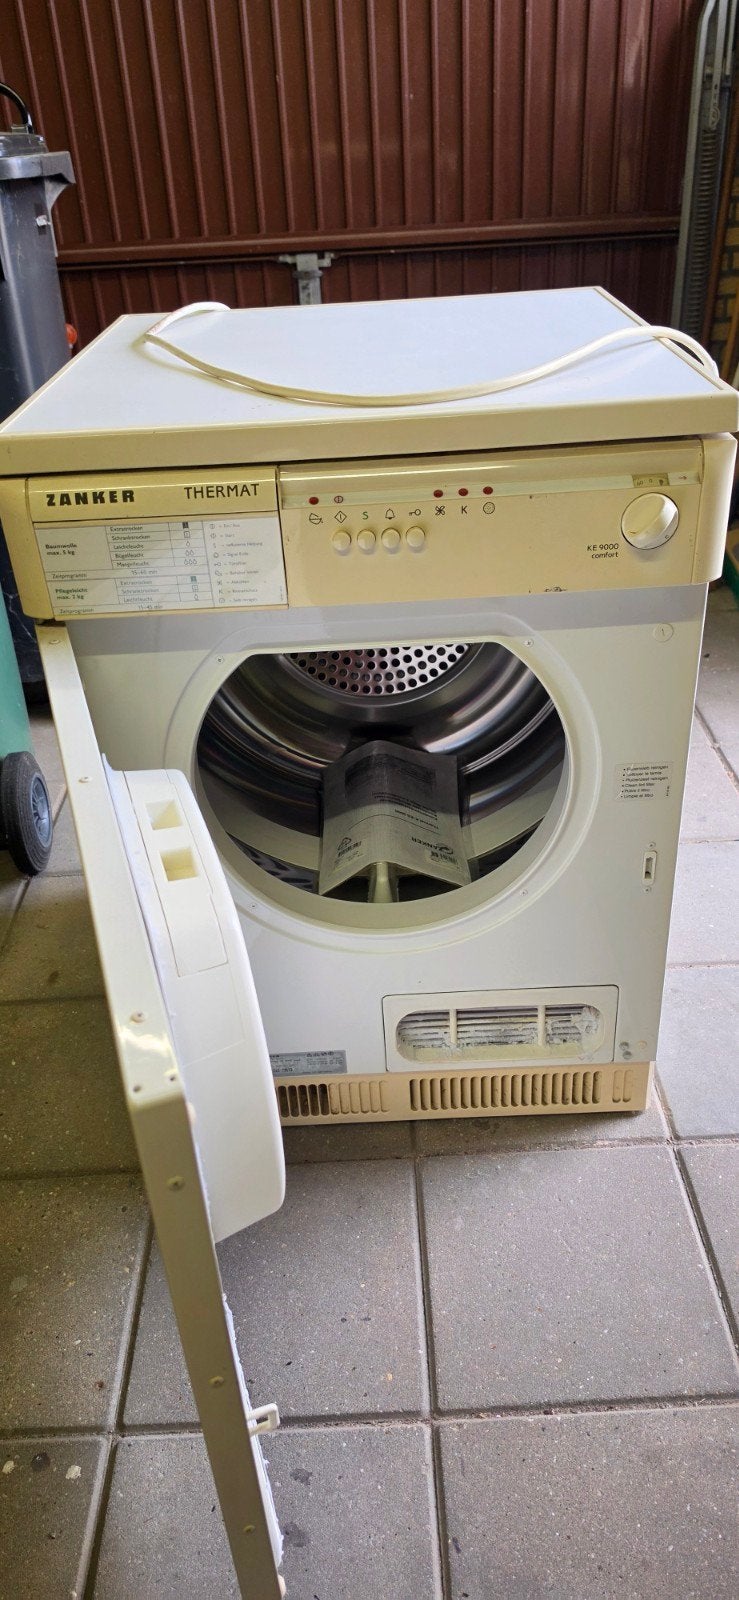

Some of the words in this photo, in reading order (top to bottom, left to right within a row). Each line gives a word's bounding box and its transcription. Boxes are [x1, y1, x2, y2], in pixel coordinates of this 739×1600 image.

[184, 483, 259, 499] THERMAT
[46, 489, 135, 506] ZANKER
[461, 505, 468, 514] K
[362, 511, 369, 520] S
[587, 544, 598, 552] KE
[599, 543, 619, 551] 9000
[592, 551, 619, 559] comfort
